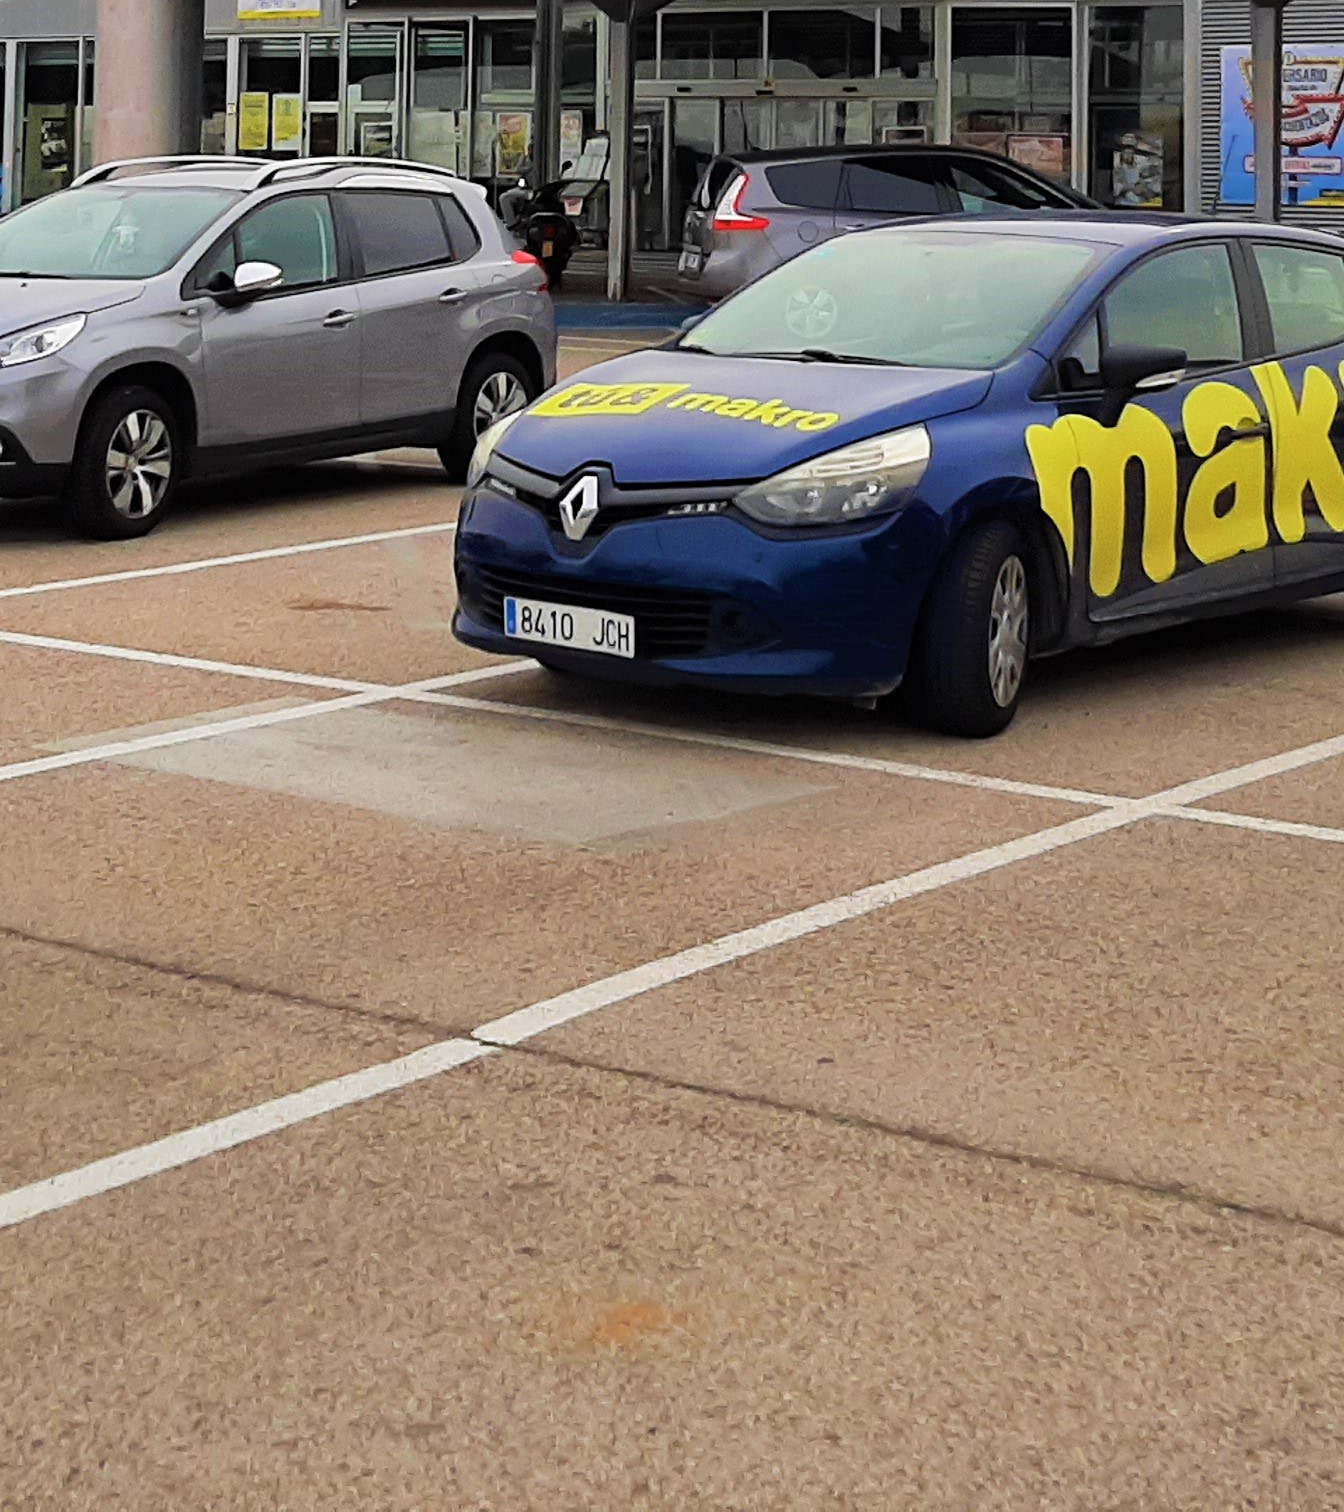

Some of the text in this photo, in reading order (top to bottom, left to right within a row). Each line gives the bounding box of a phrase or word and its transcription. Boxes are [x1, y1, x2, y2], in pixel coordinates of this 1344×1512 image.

[666, 392, 840, 431] makro
[520, 606, 631, 652] 8410 JCH
